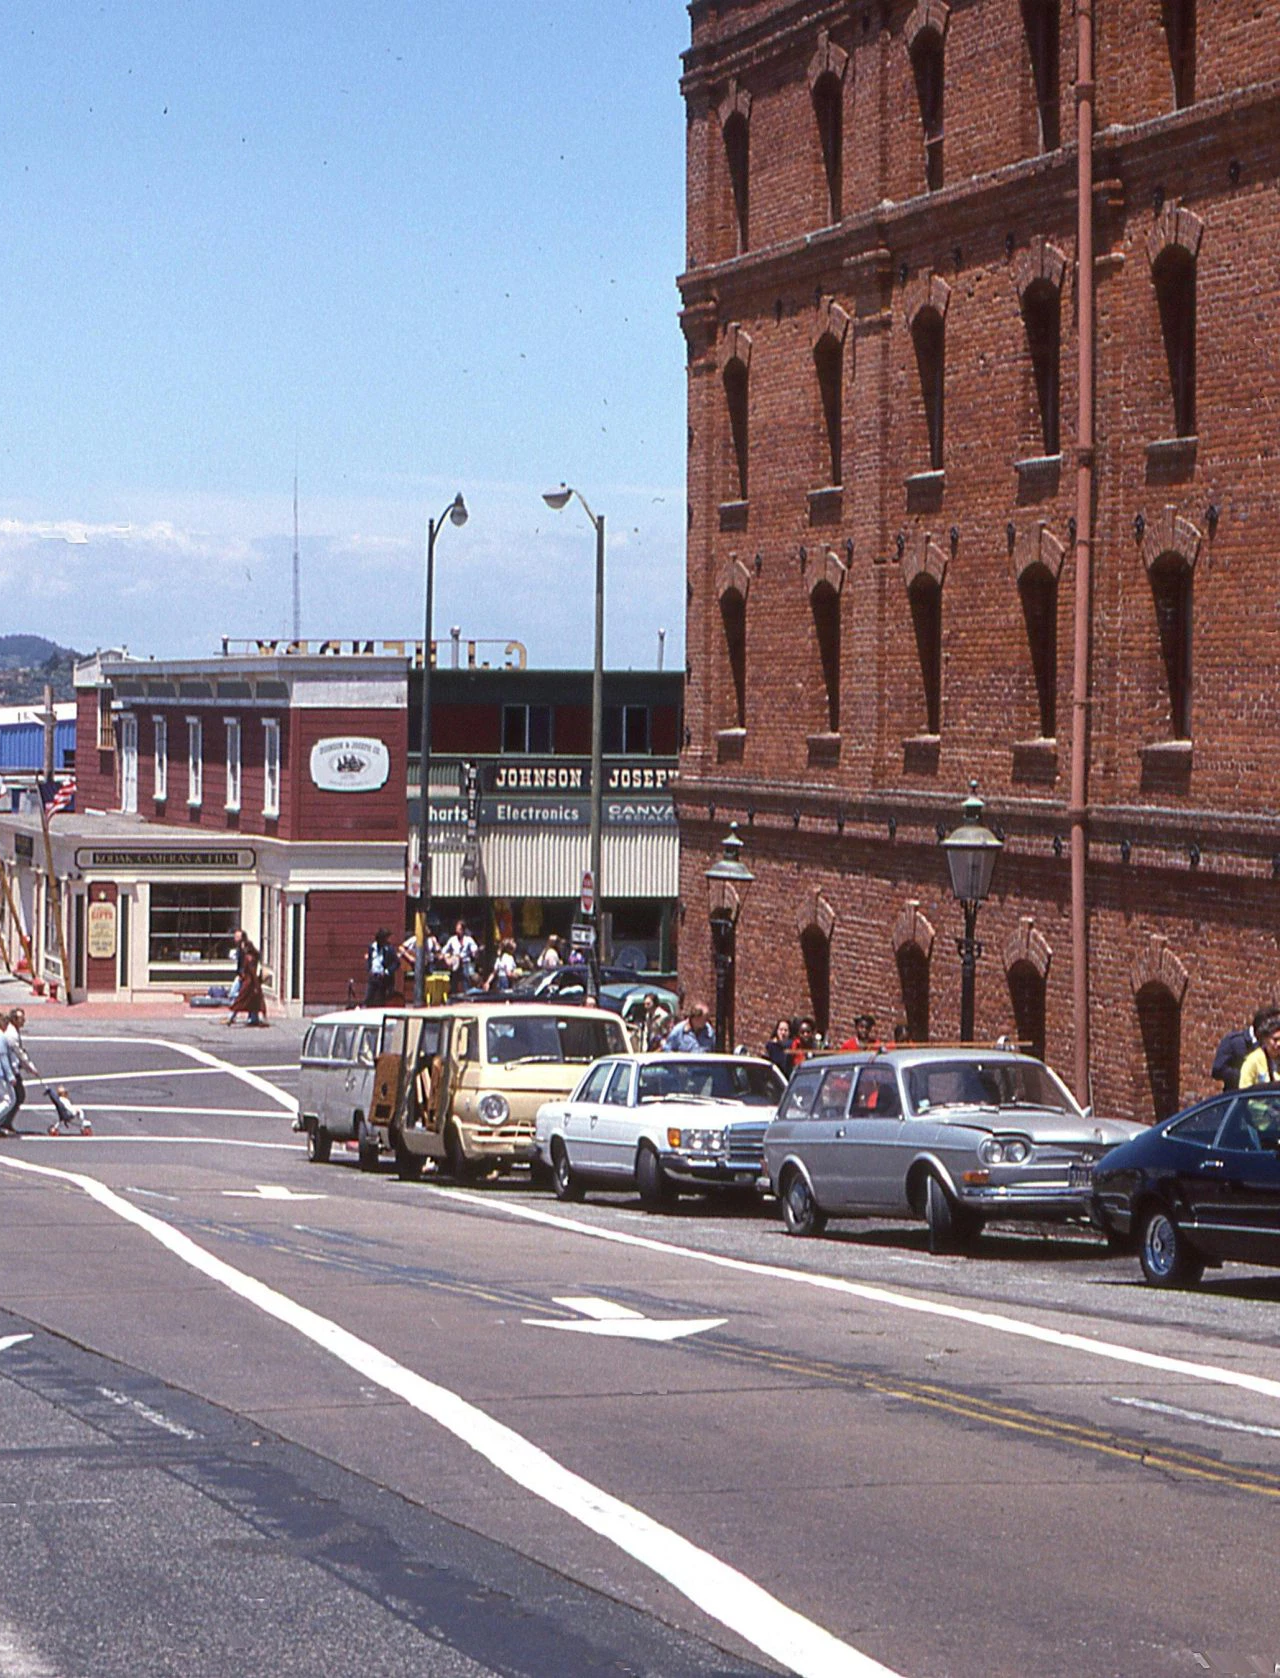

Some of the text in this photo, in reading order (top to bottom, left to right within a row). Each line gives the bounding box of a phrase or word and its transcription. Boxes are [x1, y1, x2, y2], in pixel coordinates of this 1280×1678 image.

[496, 768, 582, 788] JOHNSON
[428, 803, 580, 822] harts Electronics
[608, 805, 675, 815] CANVA
[95, 853, 133, 864] KODAK
[137, 853, 191, 864] CAMERAS
[207, 853, 237, 864] FILM
